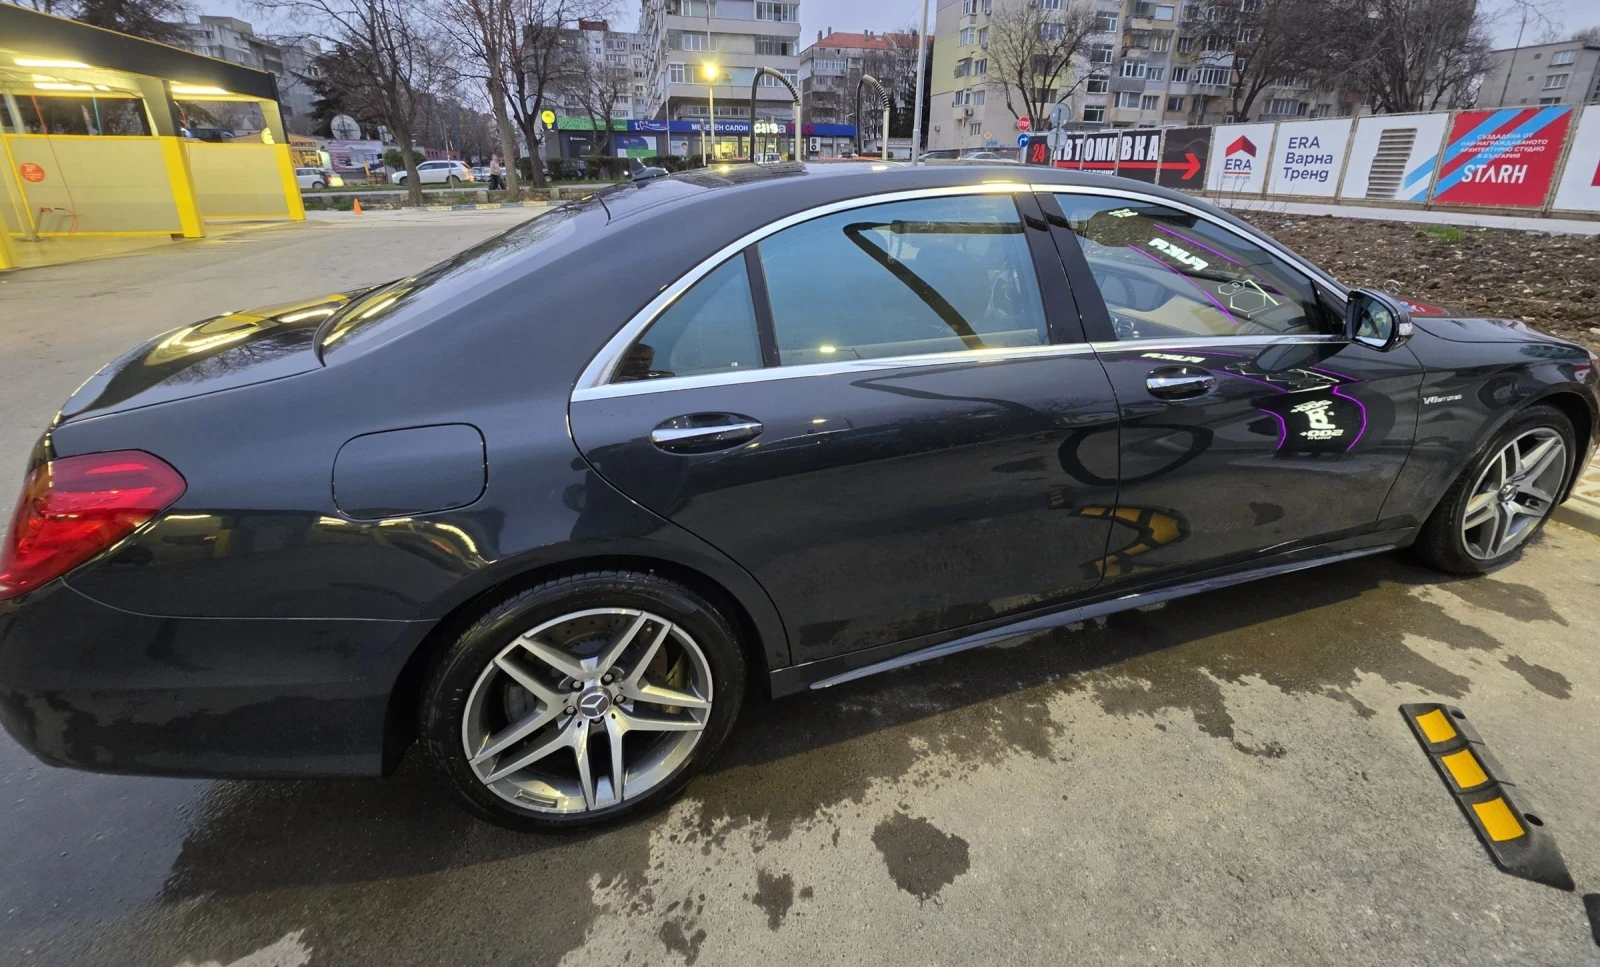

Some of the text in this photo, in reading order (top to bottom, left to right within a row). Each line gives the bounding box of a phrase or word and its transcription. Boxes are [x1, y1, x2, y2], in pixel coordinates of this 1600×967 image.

[1288, 136, 1320, 149] ERA
[1032, 143, 1046, 163] 24
[1285, 152, 1333, 167] Варна
[1224, 158, 1252, 171] ERA
[1283, 167, 1329, 183] Тренд
[1461, 164, 1528, 184] STARH
